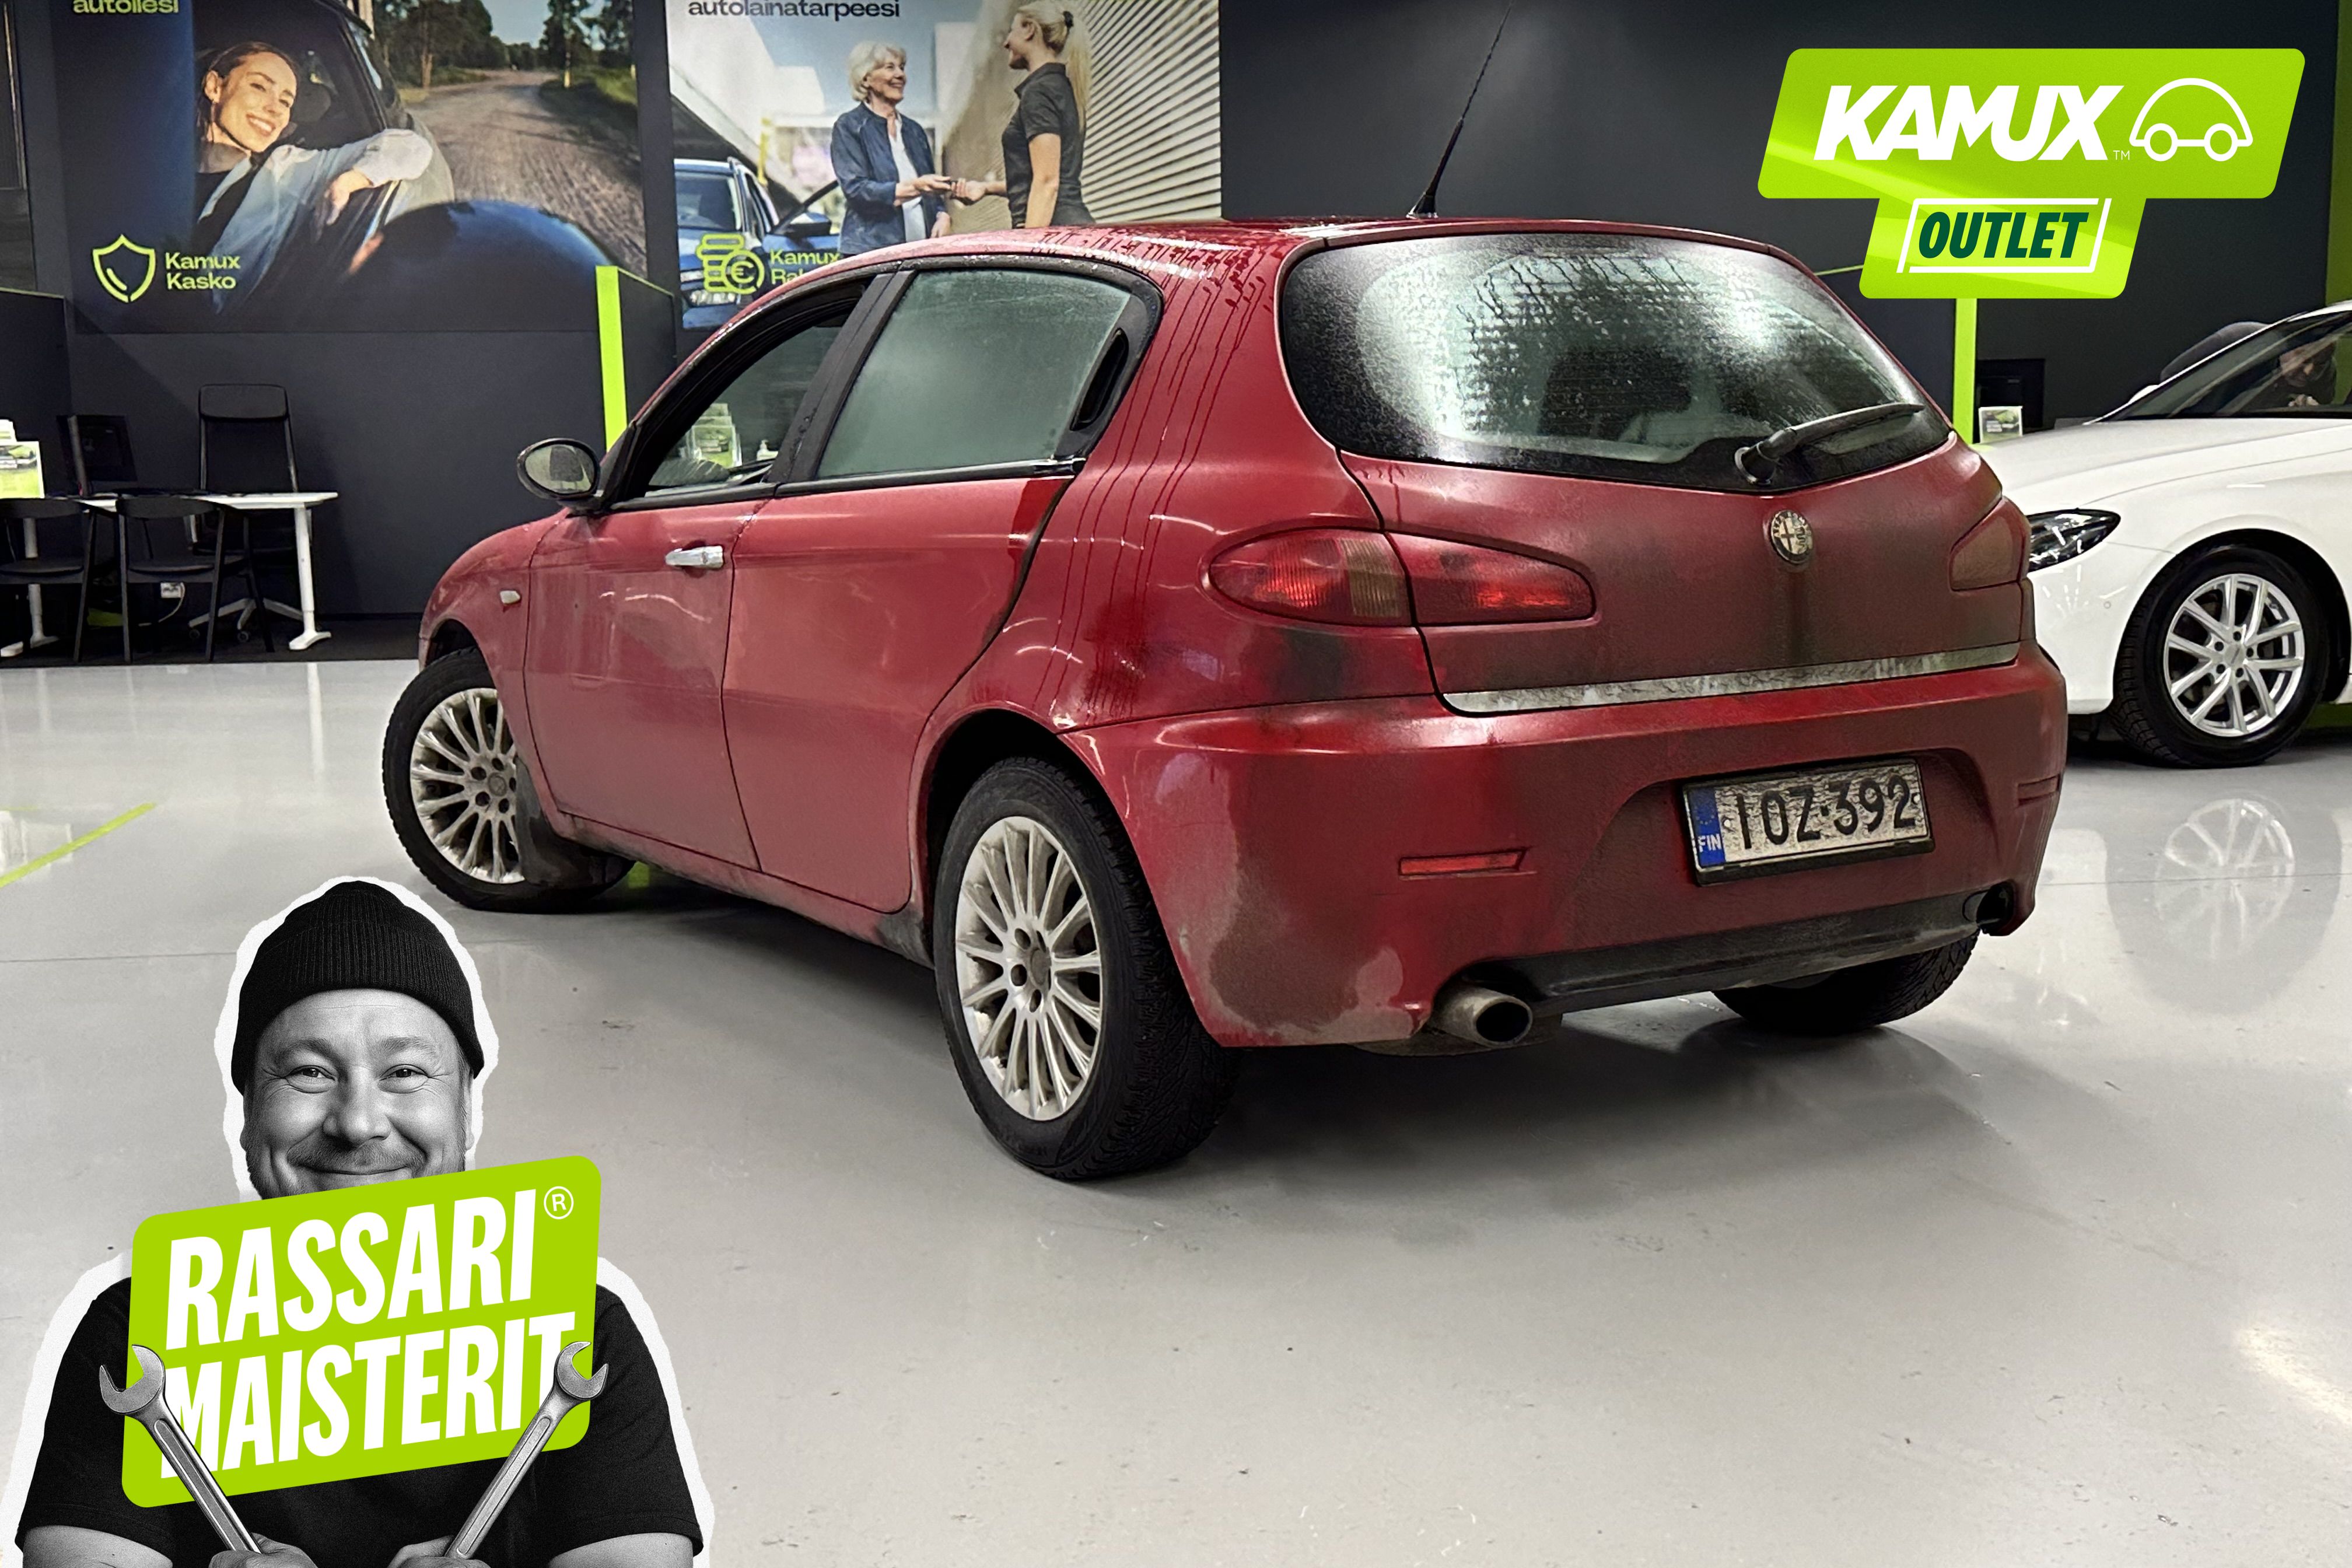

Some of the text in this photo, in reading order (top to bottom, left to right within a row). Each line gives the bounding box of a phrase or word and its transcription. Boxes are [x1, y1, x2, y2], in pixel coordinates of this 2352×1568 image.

[688, 0, 900, 22] autolainatarpeesi
[164, 252, 240, 270] Kamux
[770, 249, 840, 265] Kamux
[166, 272, 236, 290] Kasko
[1698, 832, 1723, 853] FIN
